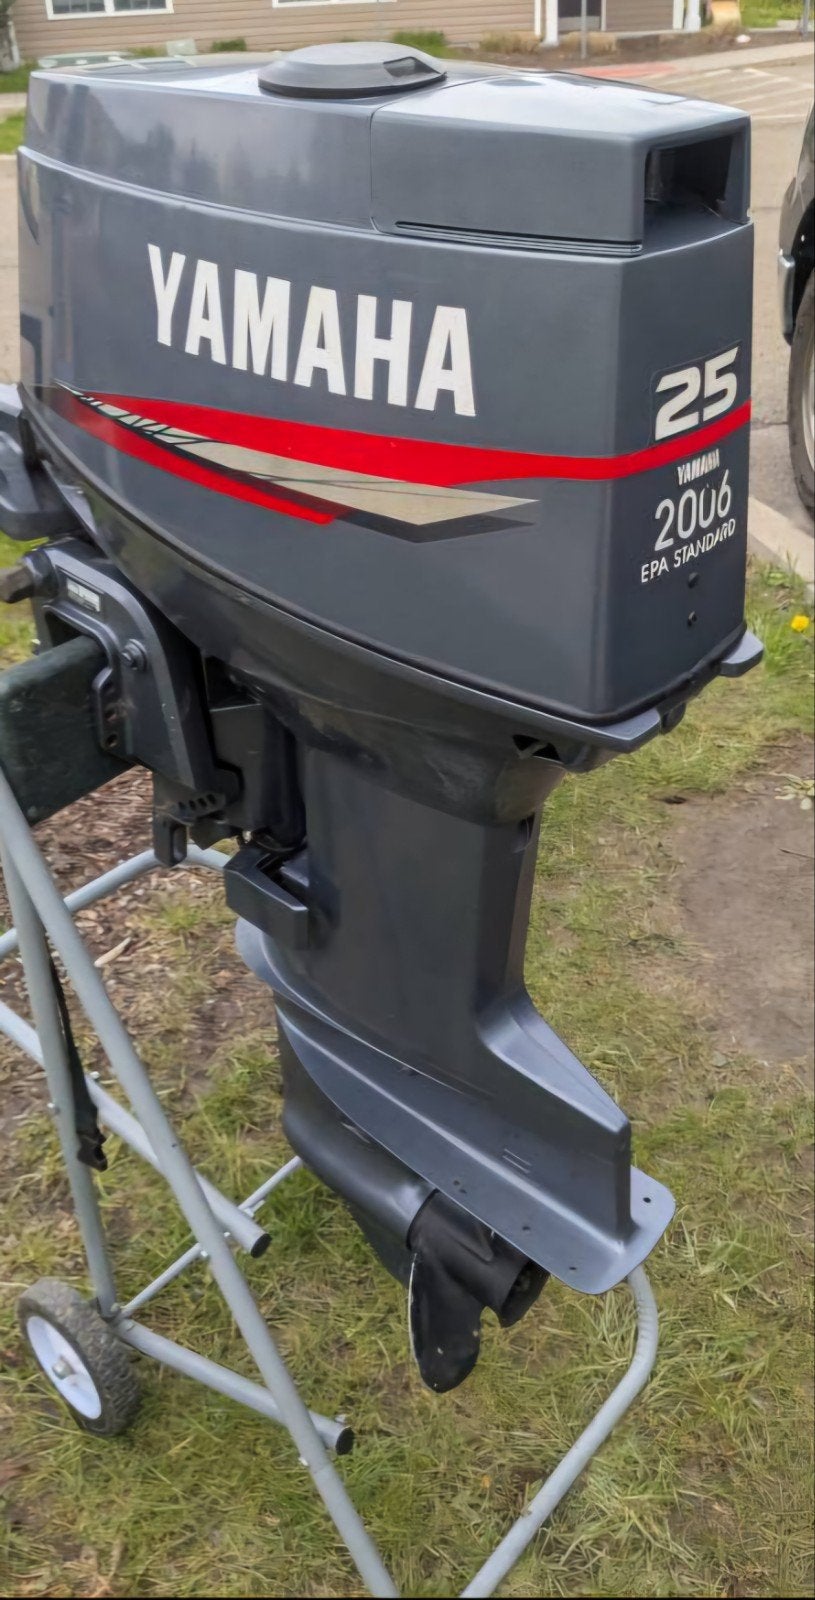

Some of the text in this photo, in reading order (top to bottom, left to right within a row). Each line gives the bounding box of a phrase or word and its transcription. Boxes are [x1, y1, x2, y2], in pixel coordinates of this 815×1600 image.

[147, 243, 476, 417] YAMAHA
[655, 346, 739, 441] 25
[641, 518, 736, 583] EPA STANDARD
[654, 469, 732, 551] 2006
